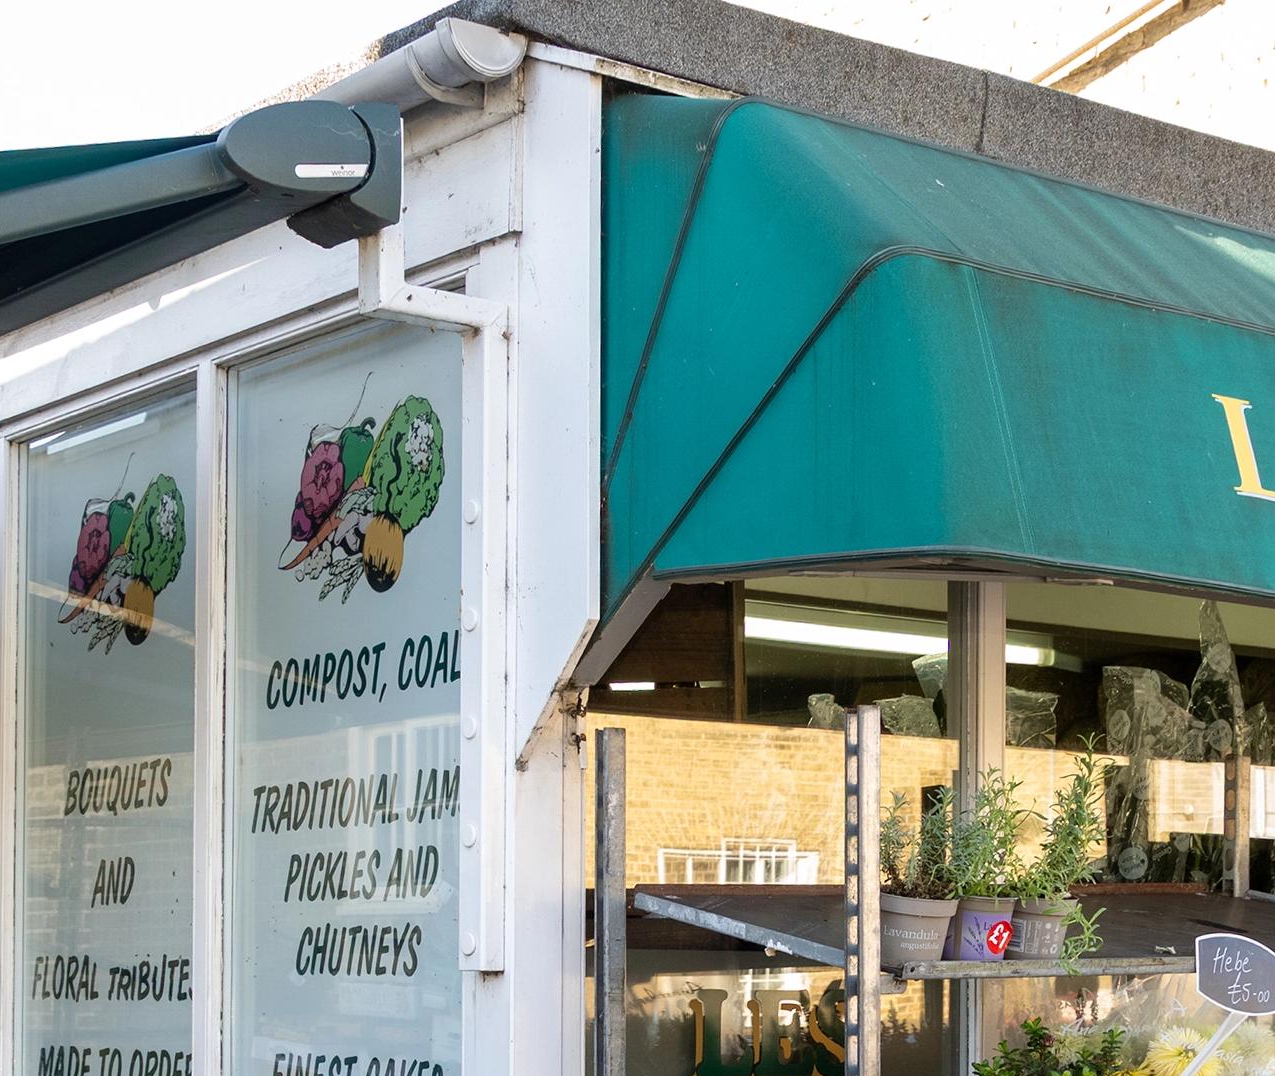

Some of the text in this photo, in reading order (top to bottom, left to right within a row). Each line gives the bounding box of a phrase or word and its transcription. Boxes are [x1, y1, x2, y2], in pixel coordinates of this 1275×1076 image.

[266, 641, 388, 710] COMPOST,
[63, 757, 173, 817] BOUQUETS
[251, 765, 461, 835] TRADITIONAL JAM
[90, 856, 136, 909] AND
[283, 845, 441, 904] PICKLES AND
[295, 922, 422, 977] CHUTNEYS
[883, 924, 939, 941] Lavandula
[987, 923, 1011, 949] £1
[31, 953, 192, 1003] FLORAL TRIBUTE
